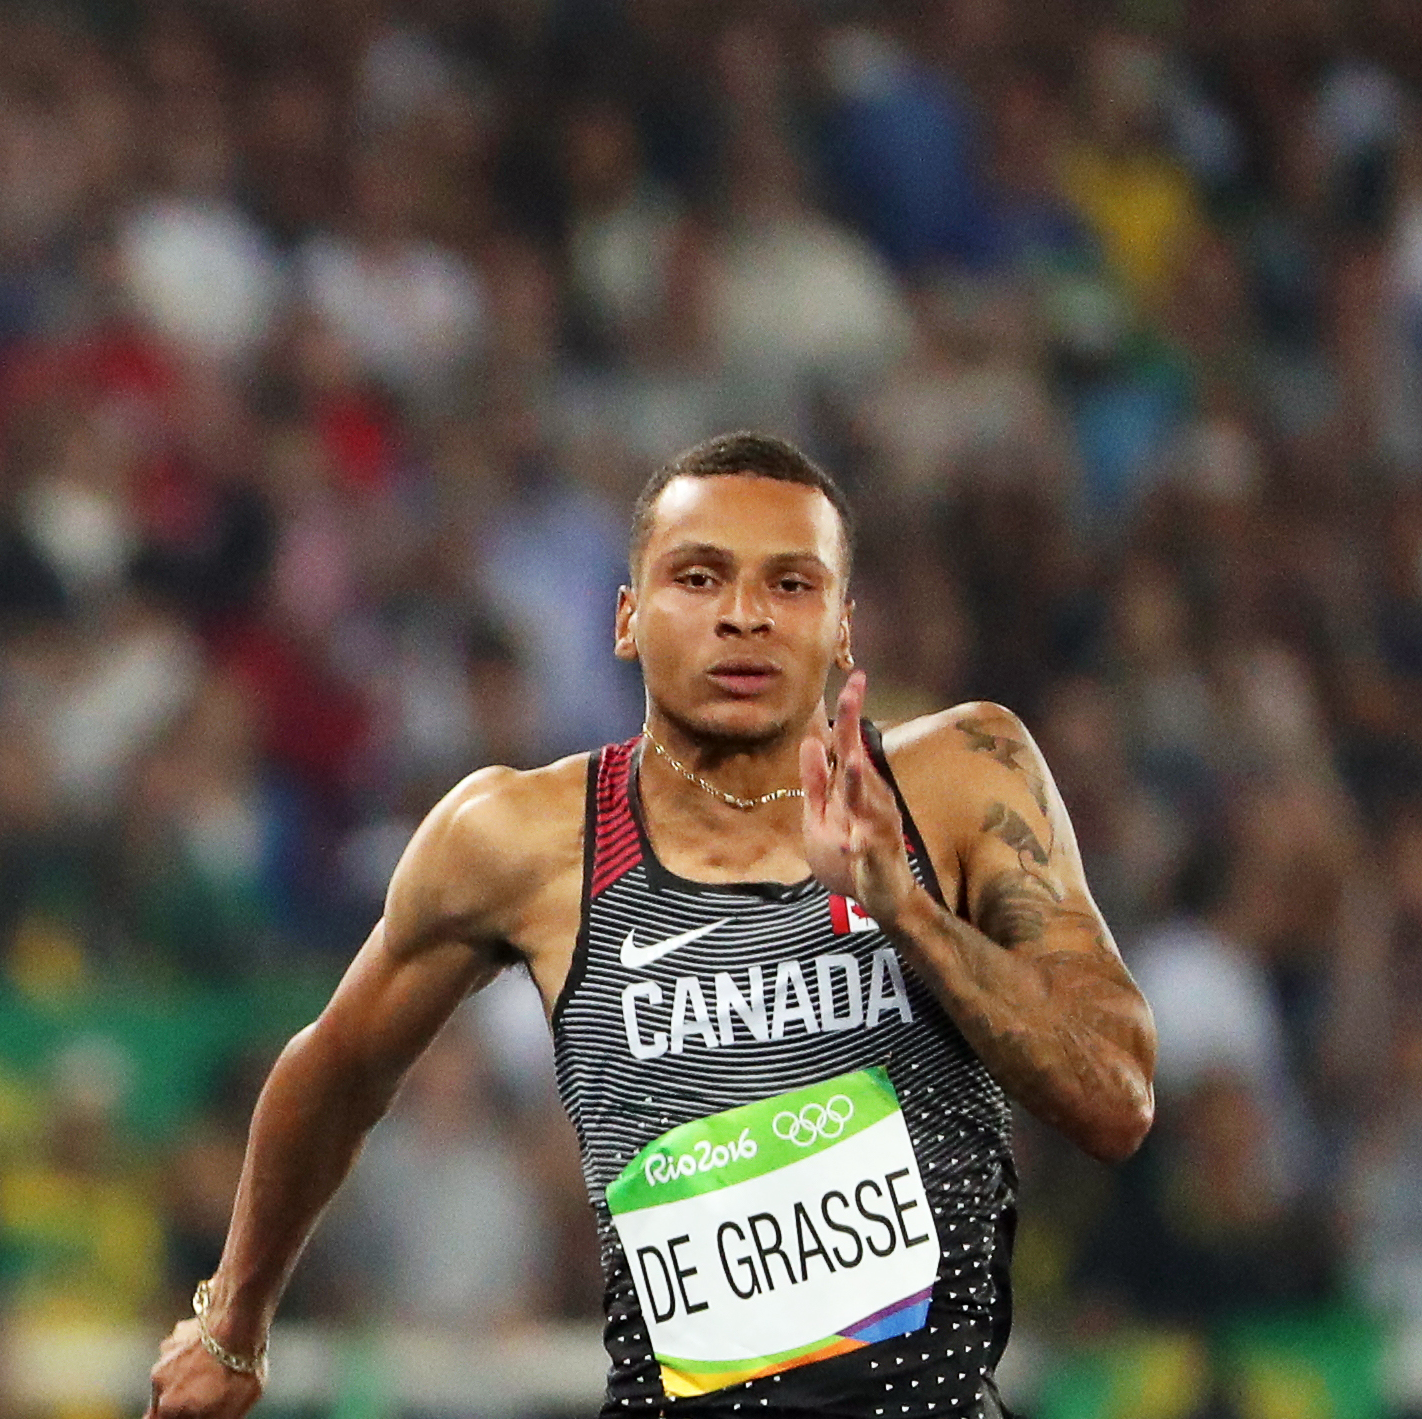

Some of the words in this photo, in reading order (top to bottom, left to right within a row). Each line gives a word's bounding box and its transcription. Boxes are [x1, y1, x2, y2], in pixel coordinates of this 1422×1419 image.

[620, 947, 914, 1061] CANADA
[644, 1127, 758, 1187] Rio2016
[636, 1234, 710, 1325] DE
[716, 1167, 930, 1301] GRASSE
